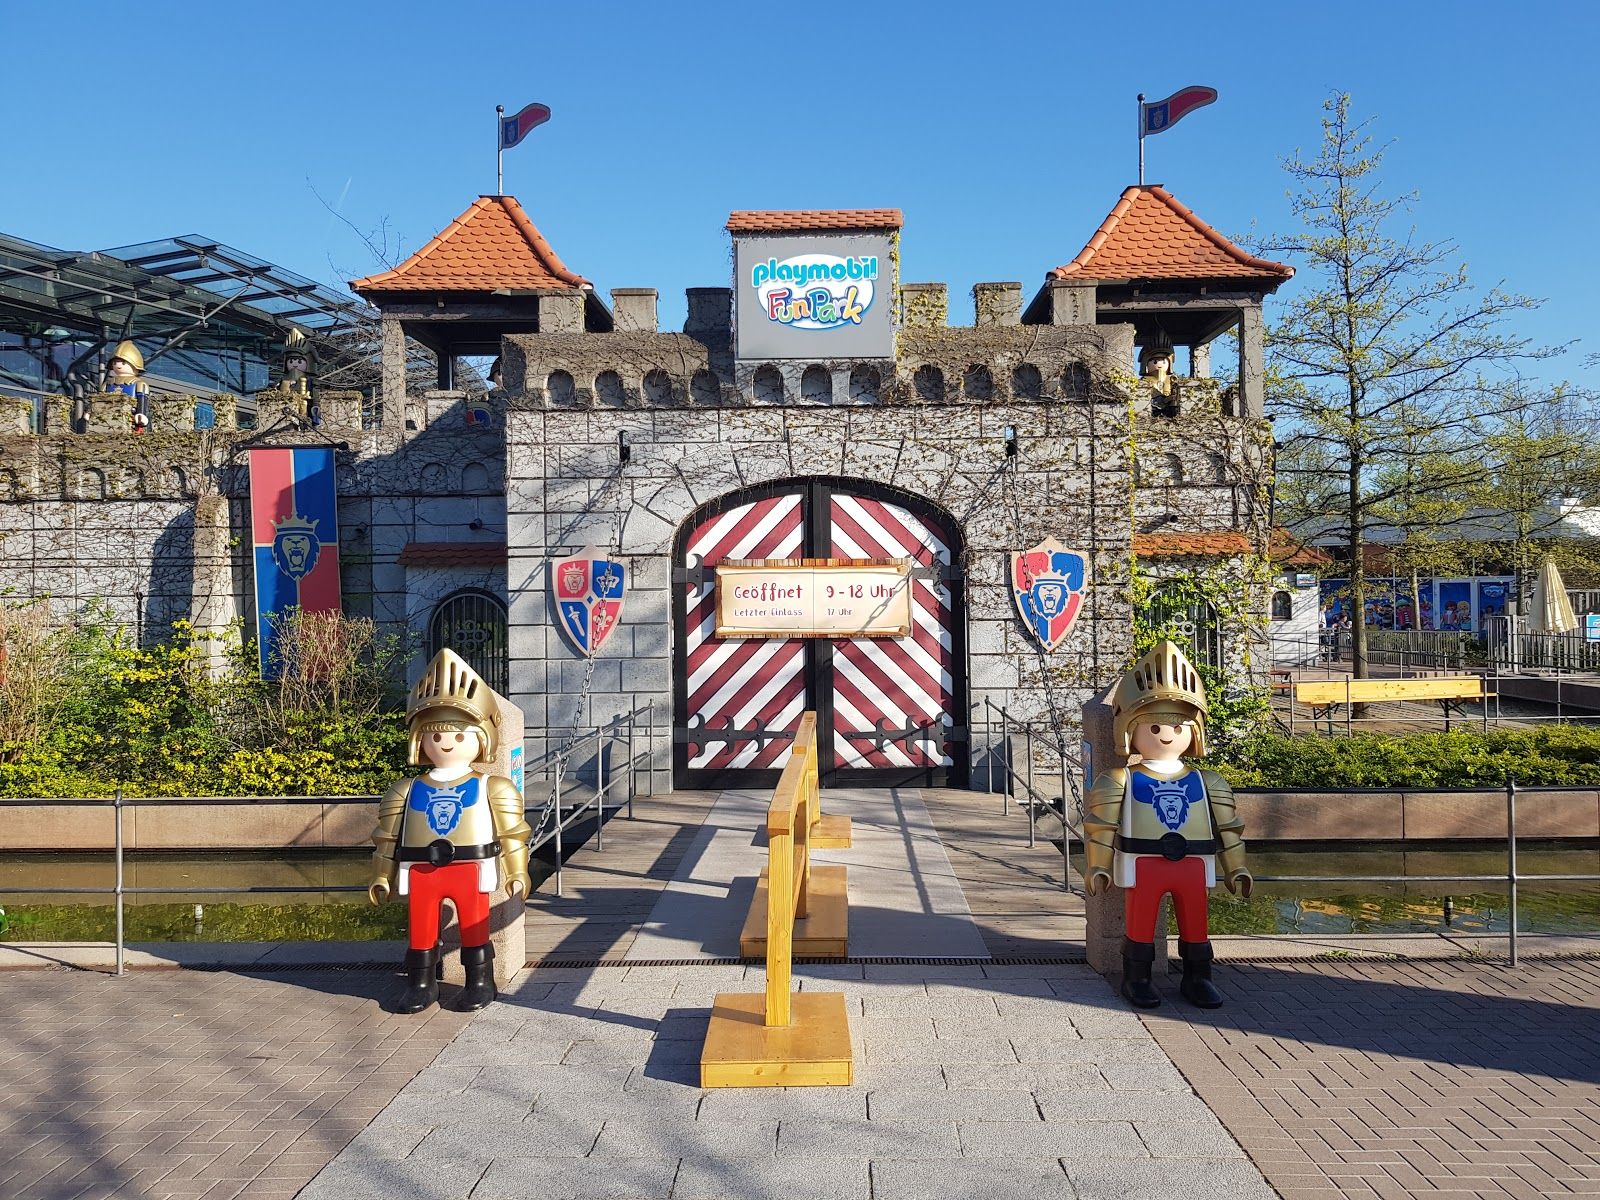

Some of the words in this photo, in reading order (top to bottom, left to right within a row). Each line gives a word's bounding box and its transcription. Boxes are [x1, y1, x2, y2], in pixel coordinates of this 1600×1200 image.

[753, 257, 877, 287] playmobil
[734, 582, 803, 601] Geöffnet
[870, 584, 896, 598] Uhr
[734, 607, 767, 617] Letzter
[771, 607, 803, 617] Einlass
[827, 608, 835, 616] 17
[838, 608, 853, 616] Uhr
